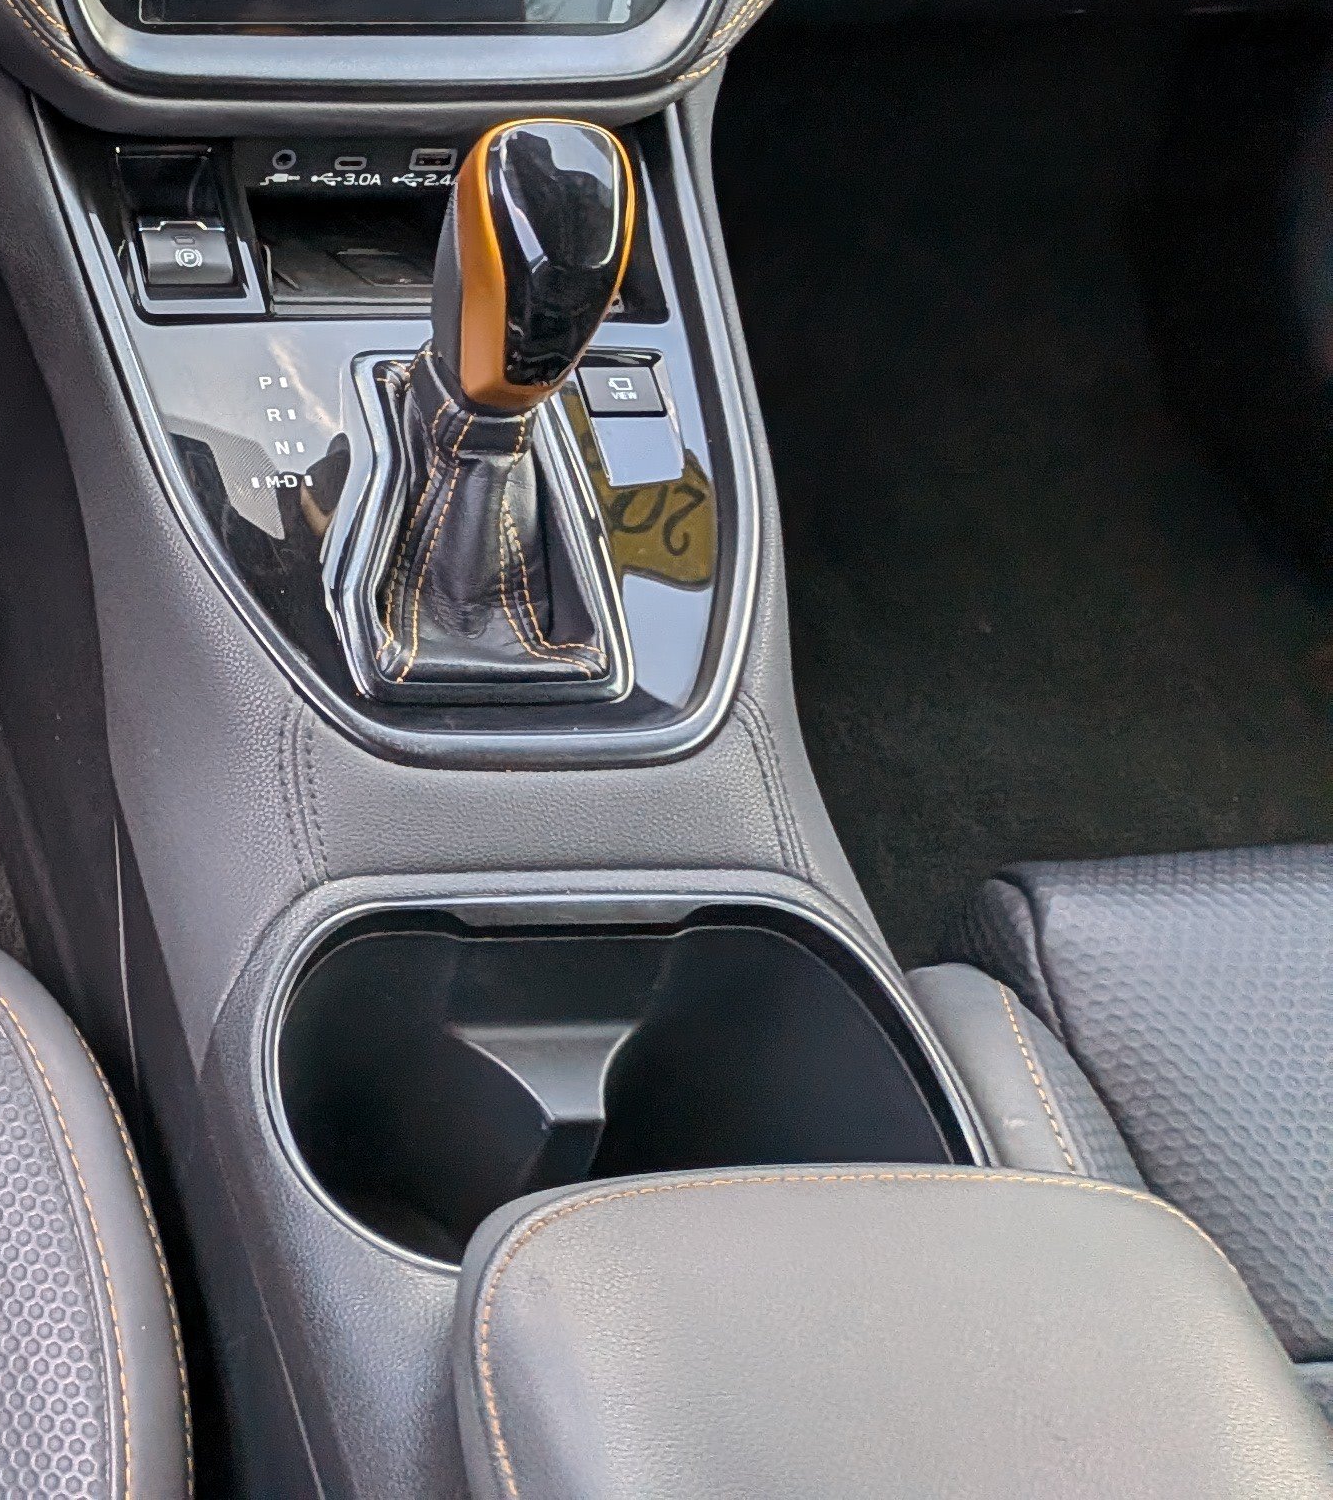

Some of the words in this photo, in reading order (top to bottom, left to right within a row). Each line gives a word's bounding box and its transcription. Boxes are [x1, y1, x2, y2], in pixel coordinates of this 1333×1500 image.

[343, 173, 381, 186] 3.0A
[258, 376, 273, 390] P
[611, 391, 638, 400] VIEW
[266, 408, 282, 422] R
[274, 440, 291, 455] N
